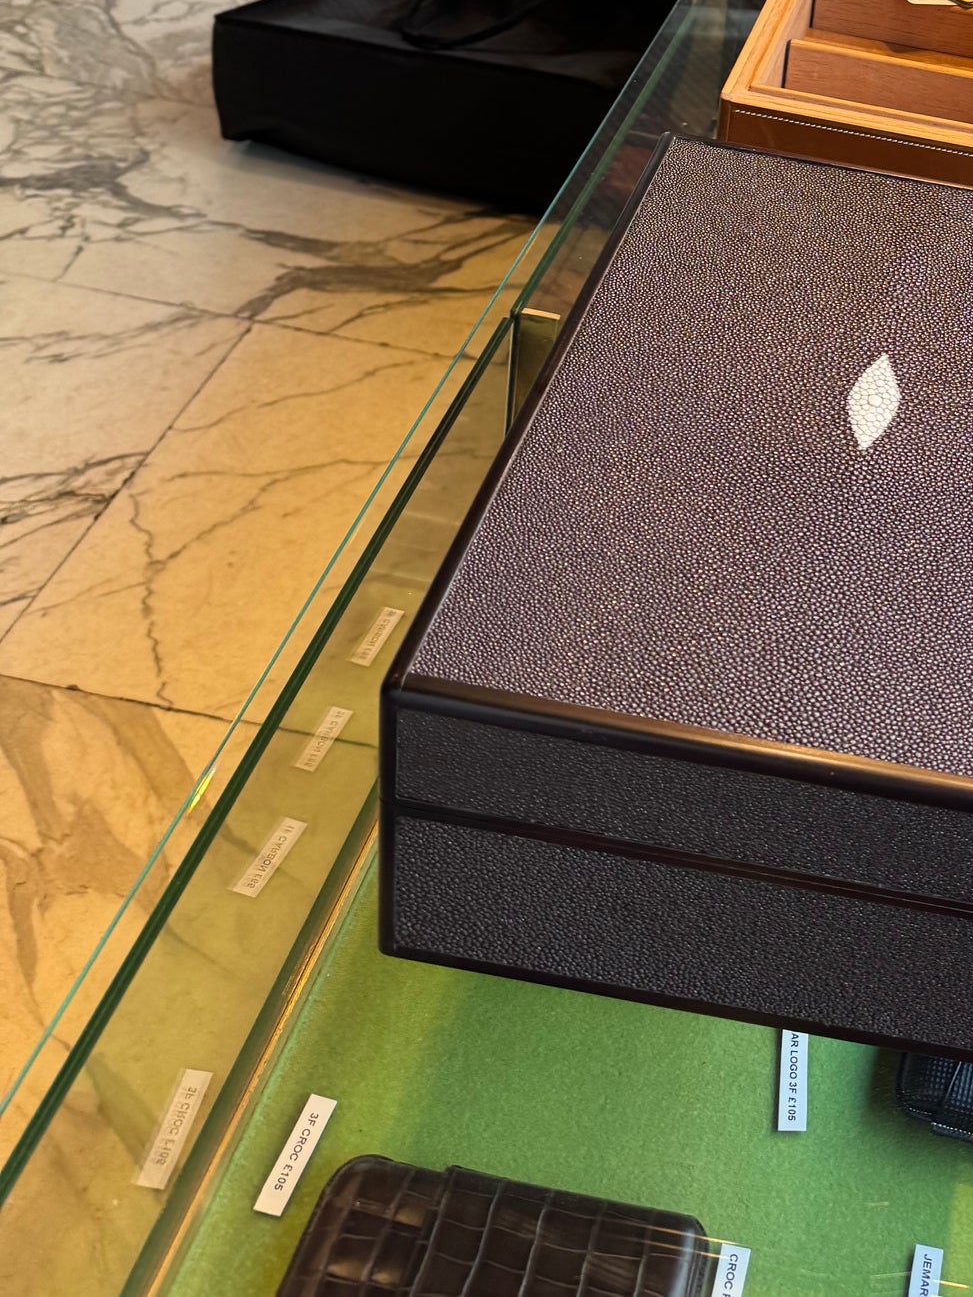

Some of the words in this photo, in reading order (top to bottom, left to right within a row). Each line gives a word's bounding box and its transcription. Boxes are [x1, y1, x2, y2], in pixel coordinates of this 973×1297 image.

[789, 1050, 799, 1080] LOGO
[788, 1082, 798, 1094] 3F
[306, 1112, 319, 1127] 3F
[787, 1096, 797, 1122] £105
[288, 1128, 311, 1162] CROC
[273, 1164, 293, 1192] £105
[724, 1253, 739, 1290] CROC
[919, 1253, 932, 1297] JEMAR
